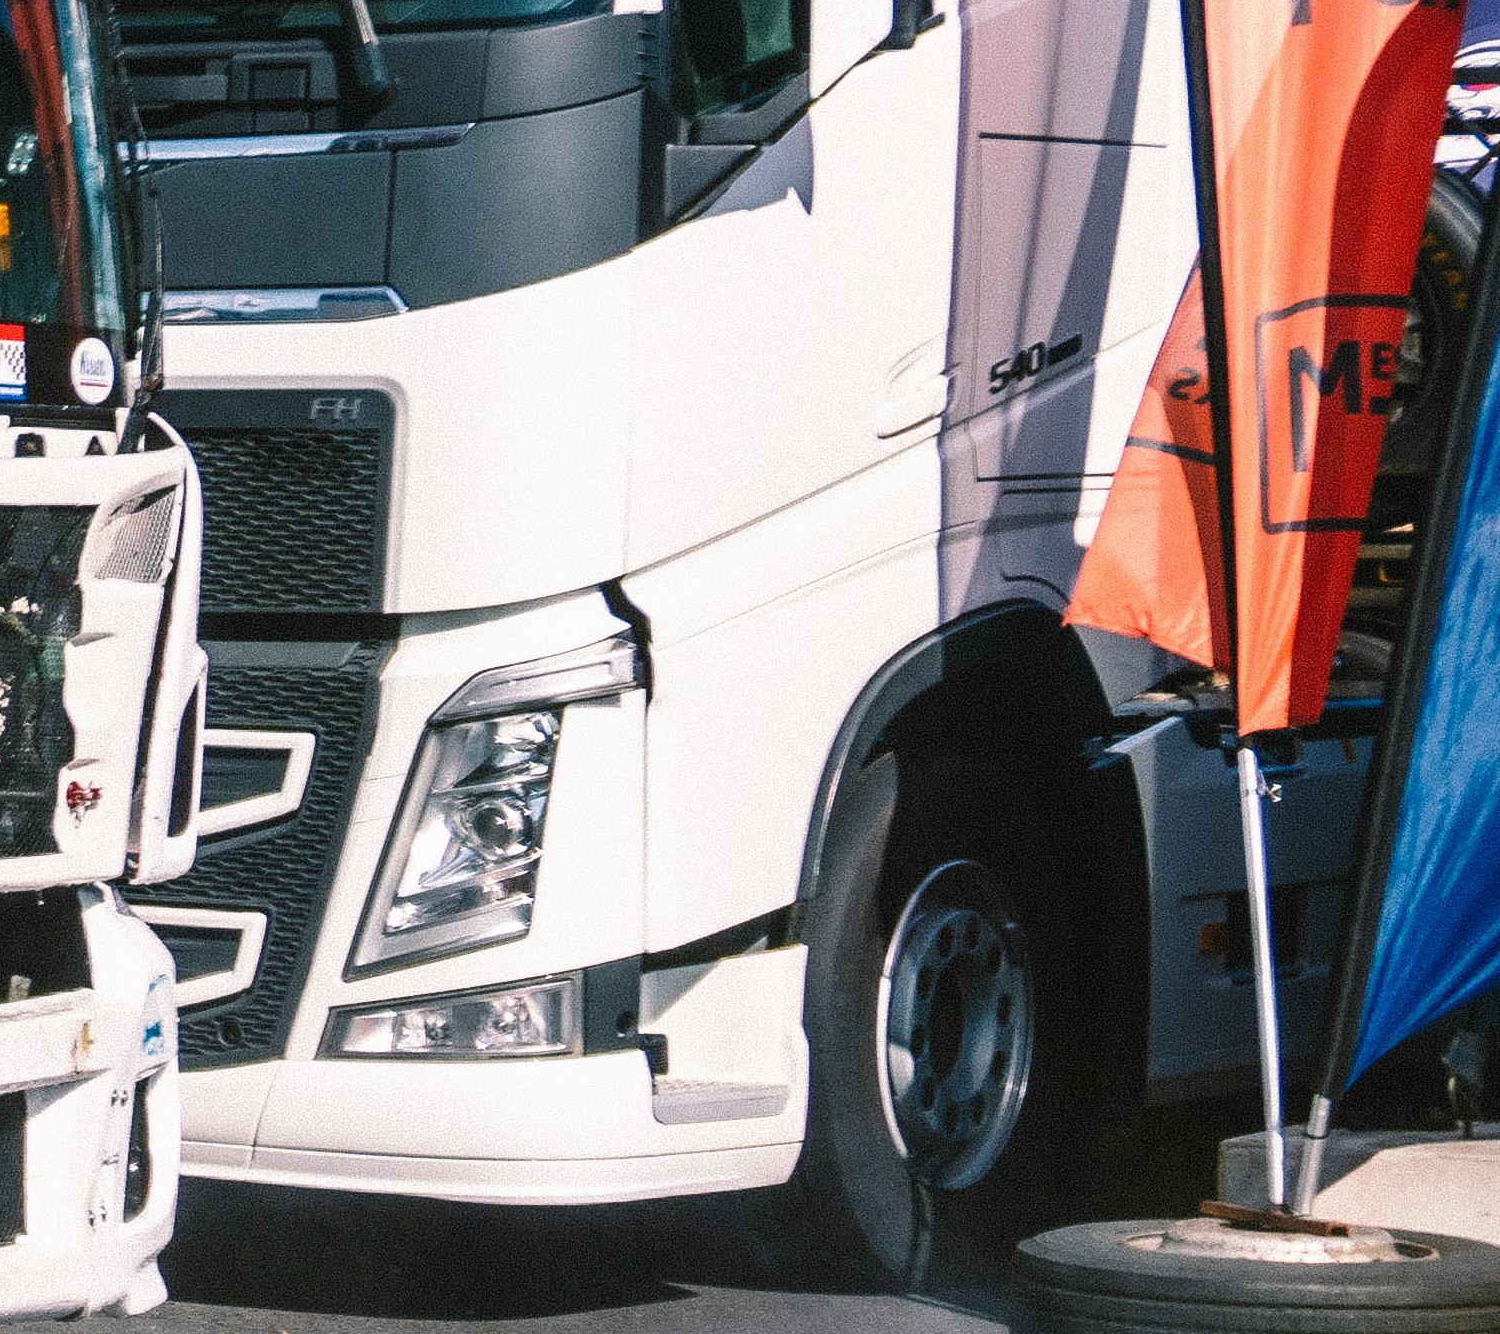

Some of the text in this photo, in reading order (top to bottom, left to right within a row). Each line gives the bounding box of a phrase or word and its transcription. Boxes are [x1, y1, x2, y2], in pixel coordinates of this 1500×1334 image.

[987, 341, 1049, 397] 540
[310, 397, 362, 422] FH
[1288, 340, 1402, 473] ME
